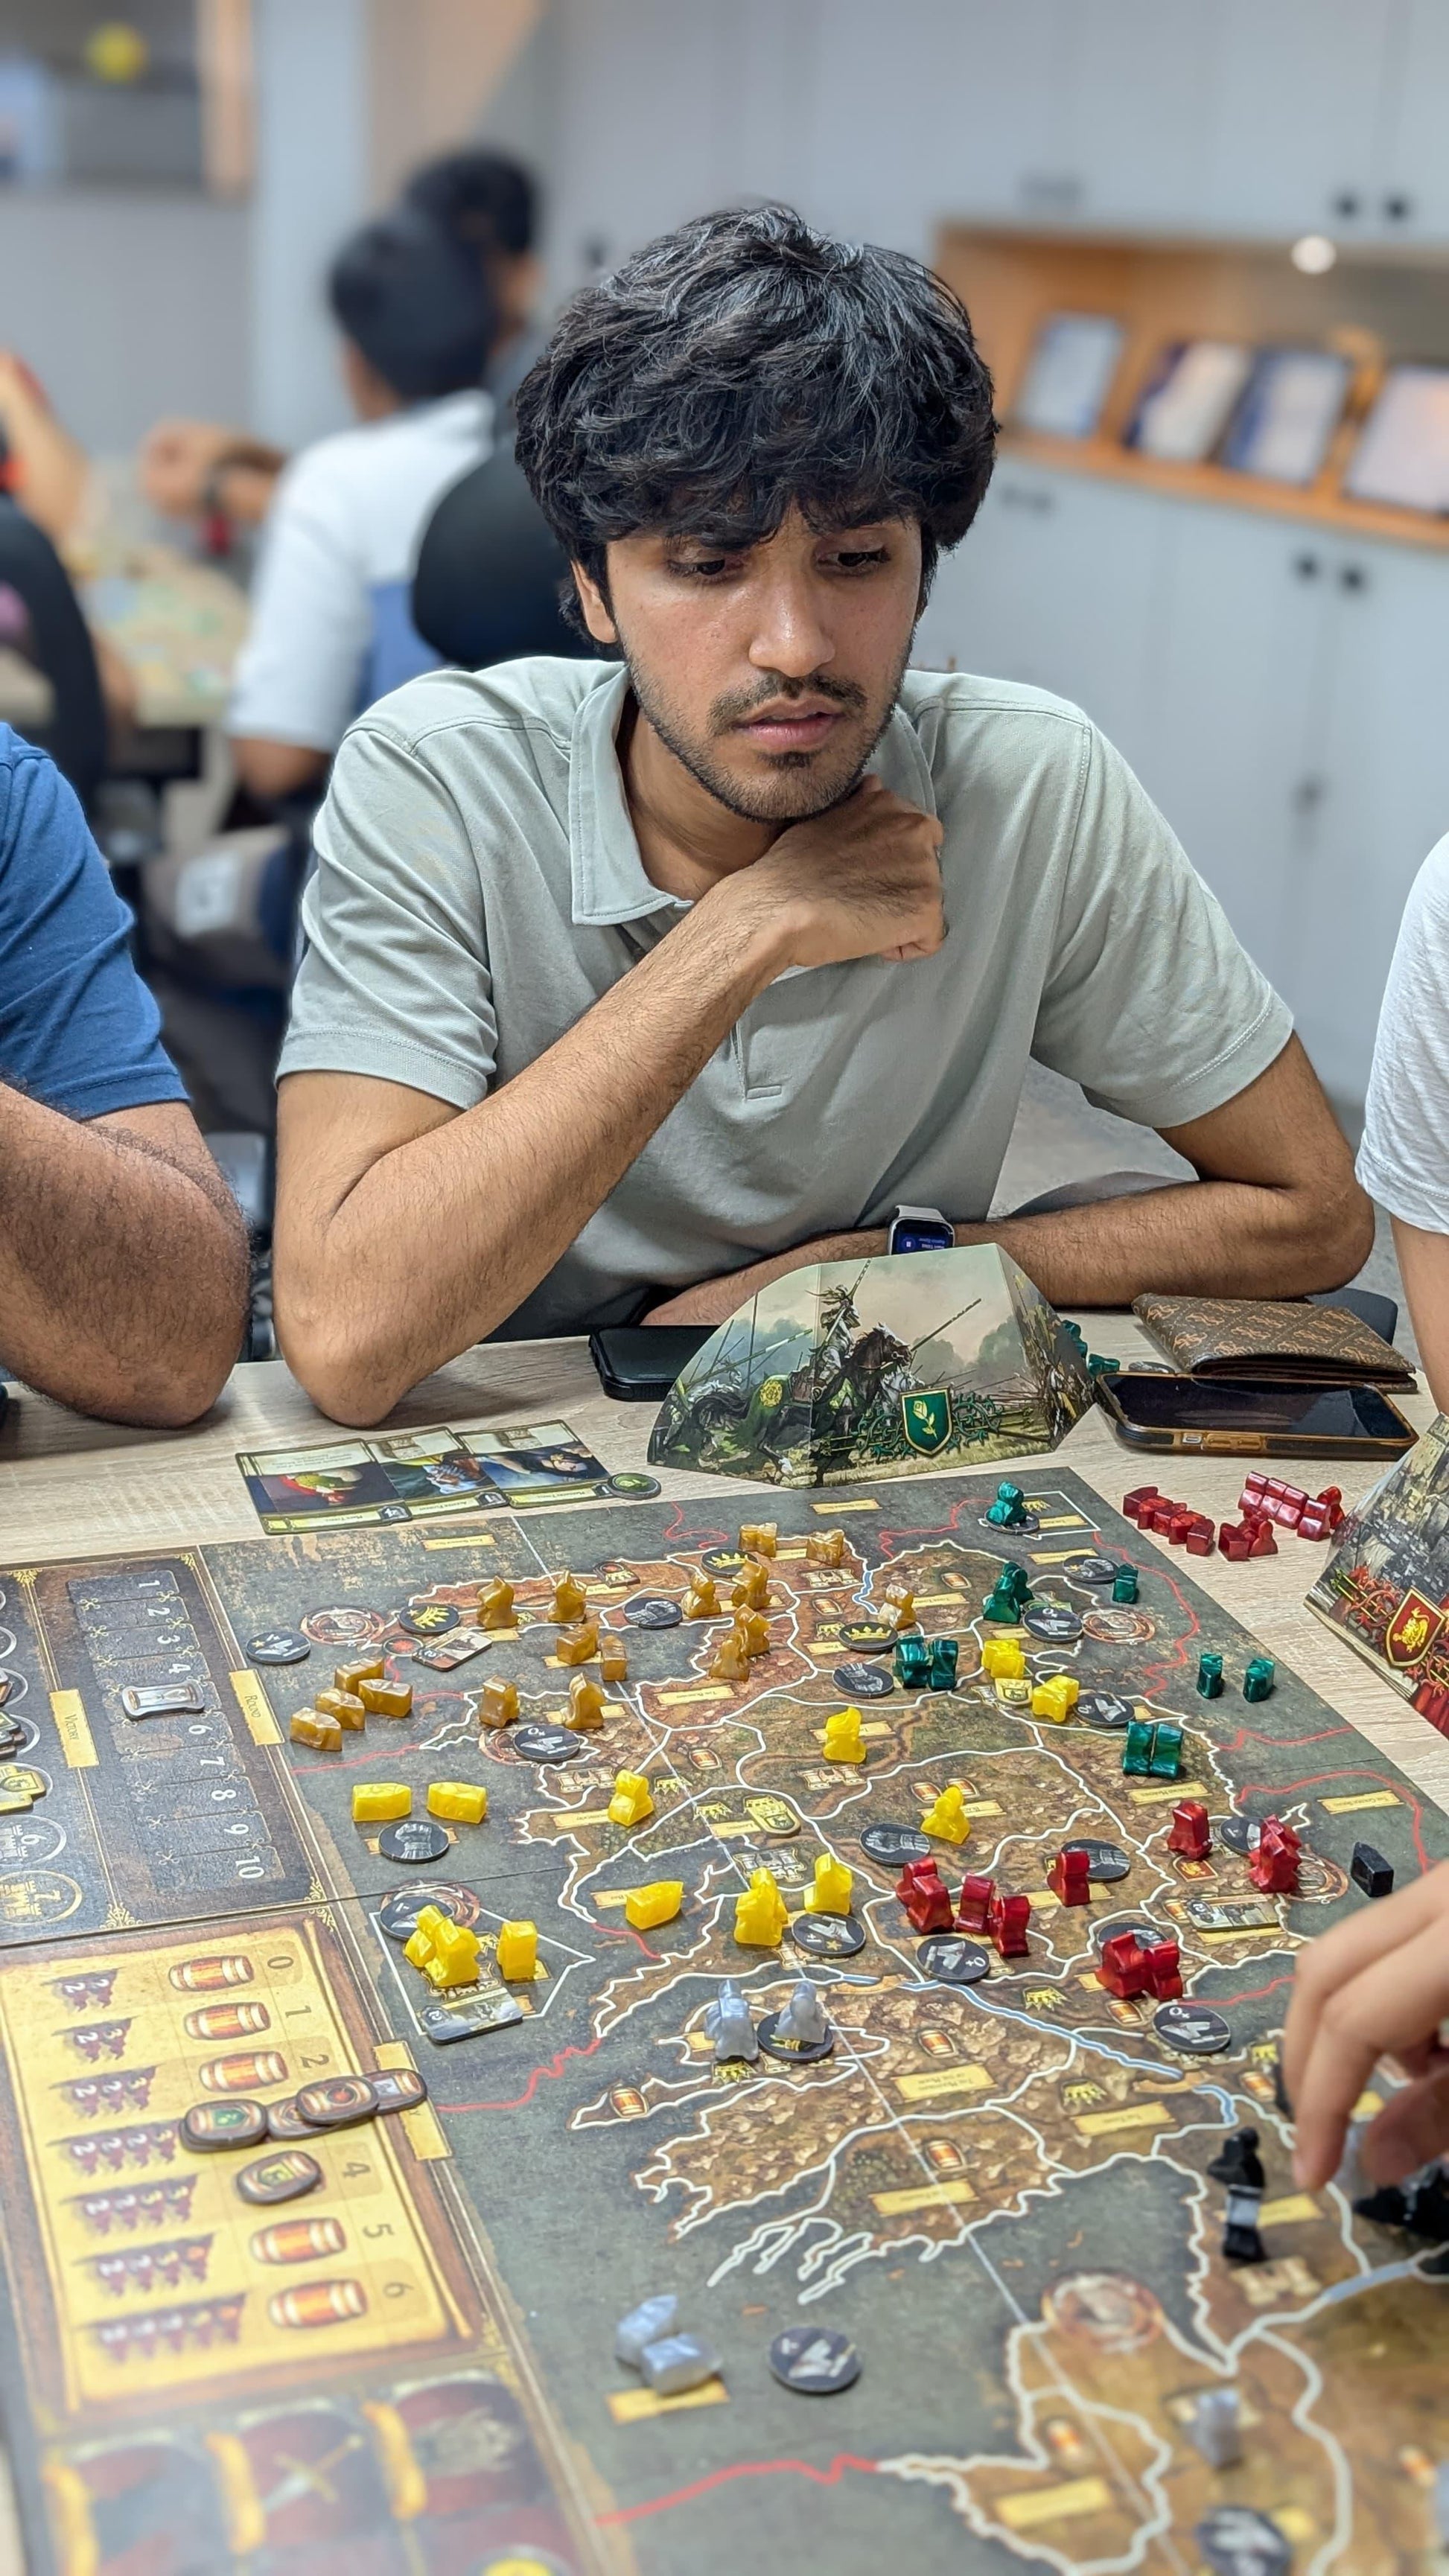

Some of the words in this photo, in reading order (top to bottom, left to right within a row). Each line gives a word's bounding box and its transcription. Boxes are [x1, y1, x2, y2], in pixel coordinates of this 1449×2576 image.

[138, 1580, 160, 1588] 1
[147, 1607, 171, 1616] 2
[157, 1634, 180, 1644] 3
[168, 1663, 191, 1674] 4
[188, 1724, 213, 1735] 6
[200, 1756, 226, 1767] 7
[211, 1789, 237, 1801] 8
[223, 1823, 249, 1835] 9
[20, 1834, 47, 1845] 6
[235, 1856, 265, 1879] 10
[34, 1890, 61, 1902] 7
[267, 1955, 294, 1970] 0
[65, 1983, 86, 1993] 2
[284, 2005, 312, 2021] 1
[77, 2032, 98, 2044] 2
[300, 2053, 331, 2070] 2
[74, 2085, 97, 2098] 2
[73, 2141, 96, 2156] 2
[342, 2162, 371, 2179] 4
[363, 2223, 395, 2240] 5
[383, 2281, 414, 2298] 6
